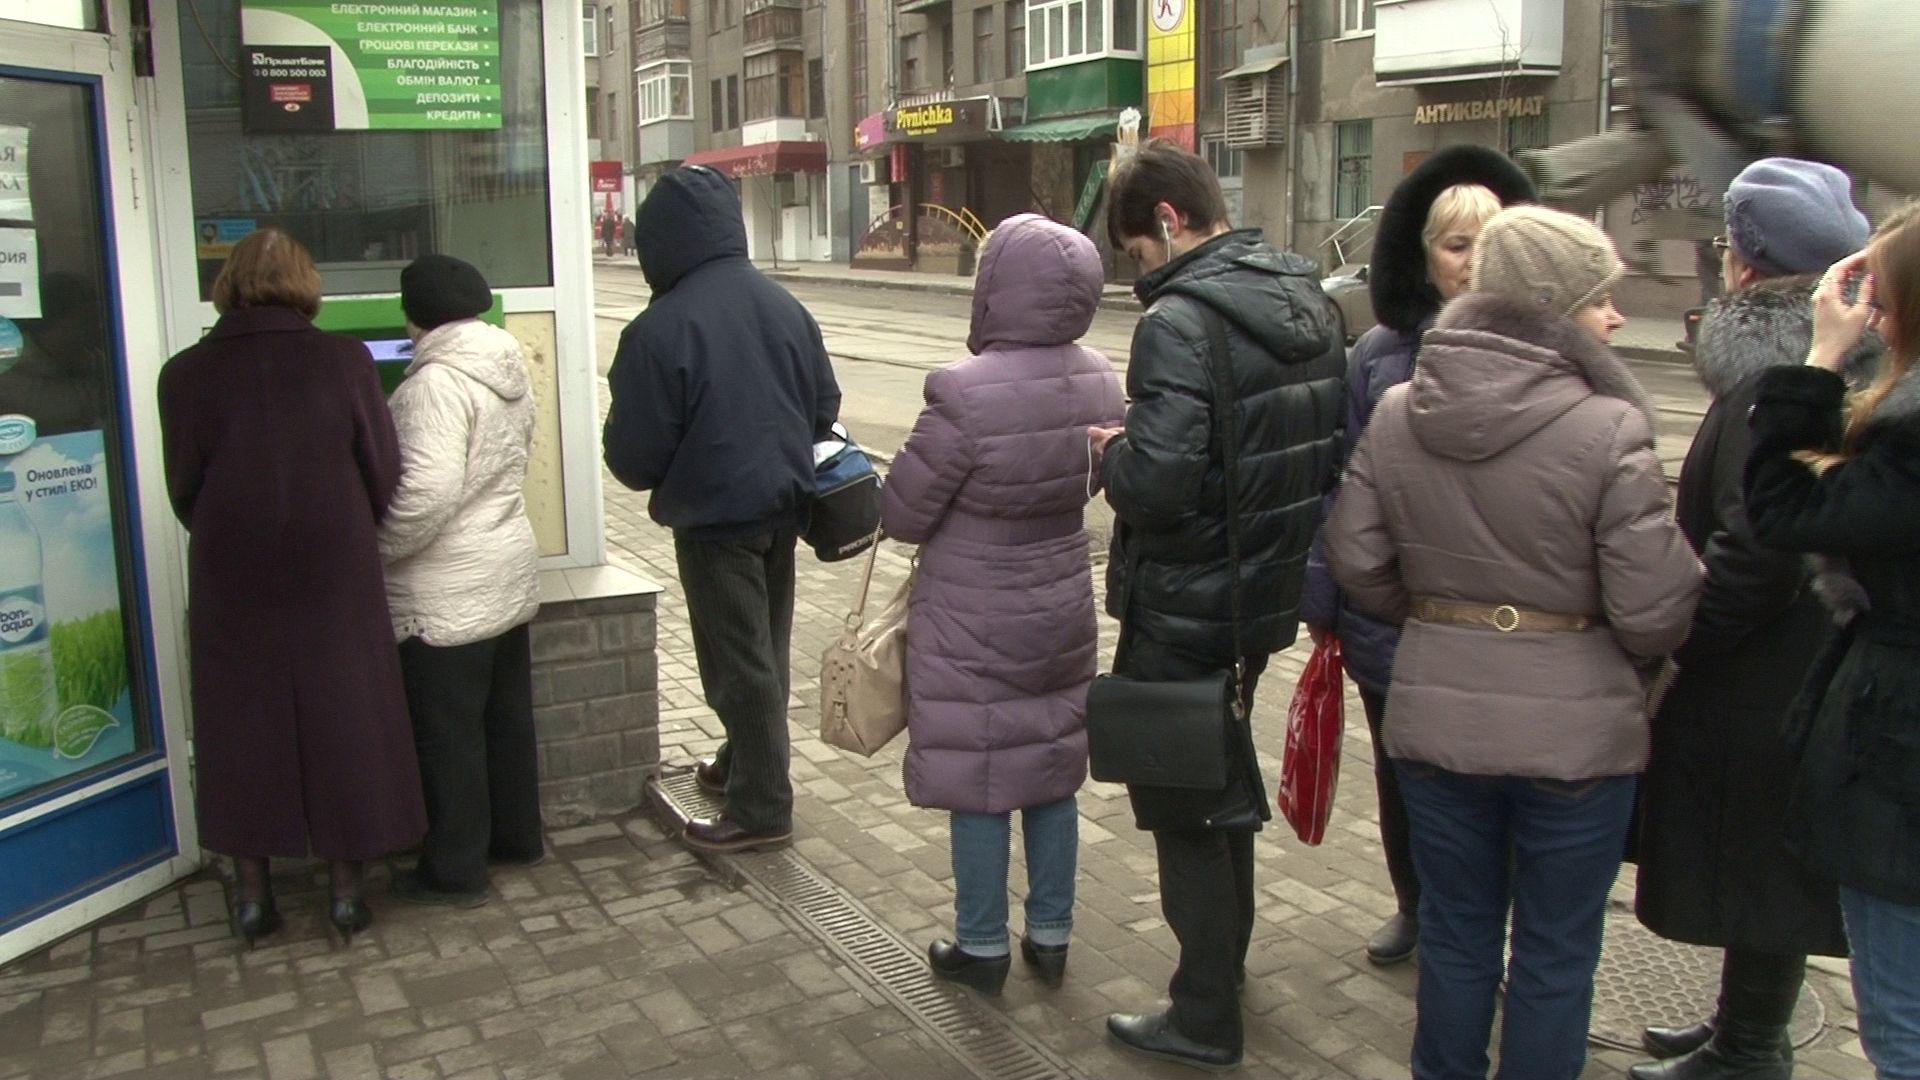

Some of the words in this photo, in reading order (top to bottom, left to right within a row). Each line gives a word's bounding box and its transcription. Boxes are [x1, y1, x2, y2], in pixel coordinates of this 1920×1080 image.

[331, 3, 420, 15] ЕЛЕКТРОННИЙ
[422, 6, 477, 17] МАГАЗИН
[357, 21, 444, 33] ЕЛЕКТРОННИЙ
[447, 24, 478, 34] БАНК
[359, 39, 415, 50] ГРОШОВІ
[417, 40, 479, 51] ПЕРЕКАЗИ
[387, 57, 480, 71] БЛАГОДІЙНІСТЬ
[396, 75, 436, 86] ОБМІН
[438, 76, 480, 86] ВАЛЮТ
[416, 93, 480, 105] ДЕПОЗИТИ
[426, 110, 481, 121] КРЕДИТИ
[896, 105, 953, 129] Pivnichka
[1414, 95, 1544, 125] АНТИКВАРИАТ
[26, 464, 92, 482] Оновлена
[35, 482, 68, 498] стилі
[70, 477, 98, 492] ЕКО!
[1, 618, 33, 633] aqua
